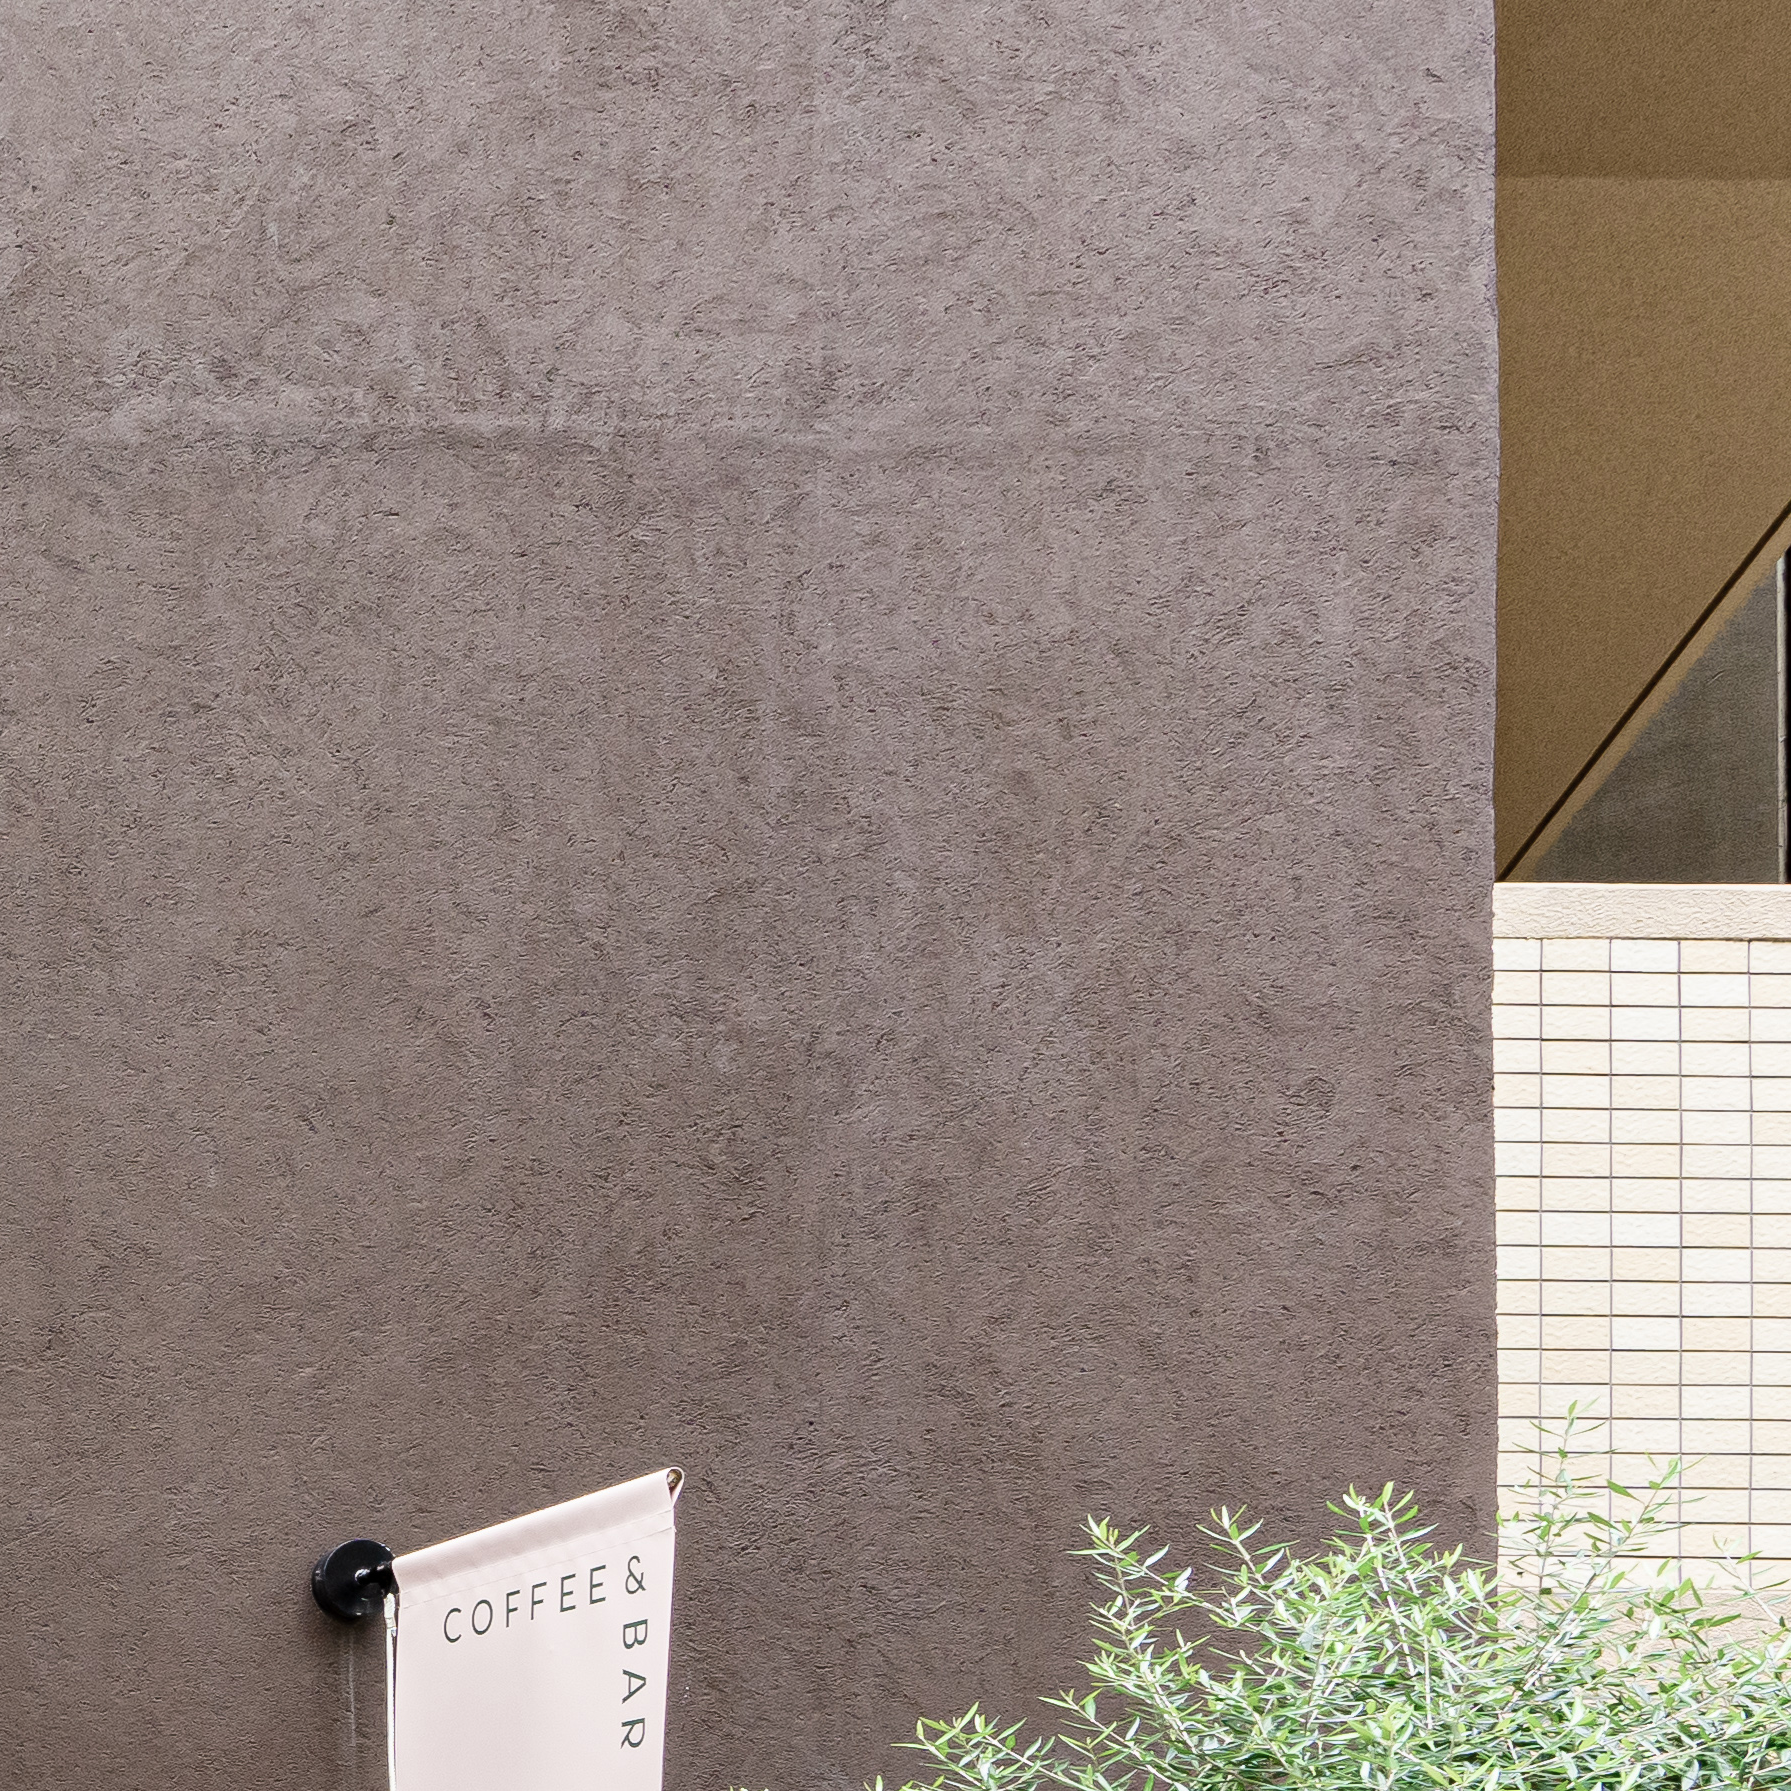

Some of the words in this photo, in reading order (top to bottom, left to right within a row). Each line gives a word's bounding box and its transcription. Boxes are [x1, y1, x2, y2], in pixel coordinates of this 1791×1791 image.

[443, 1564, 608, 1643] COFFEE
[624, 1555, 648, 1595] &
[621, 1618, 648, 1750] BAR
